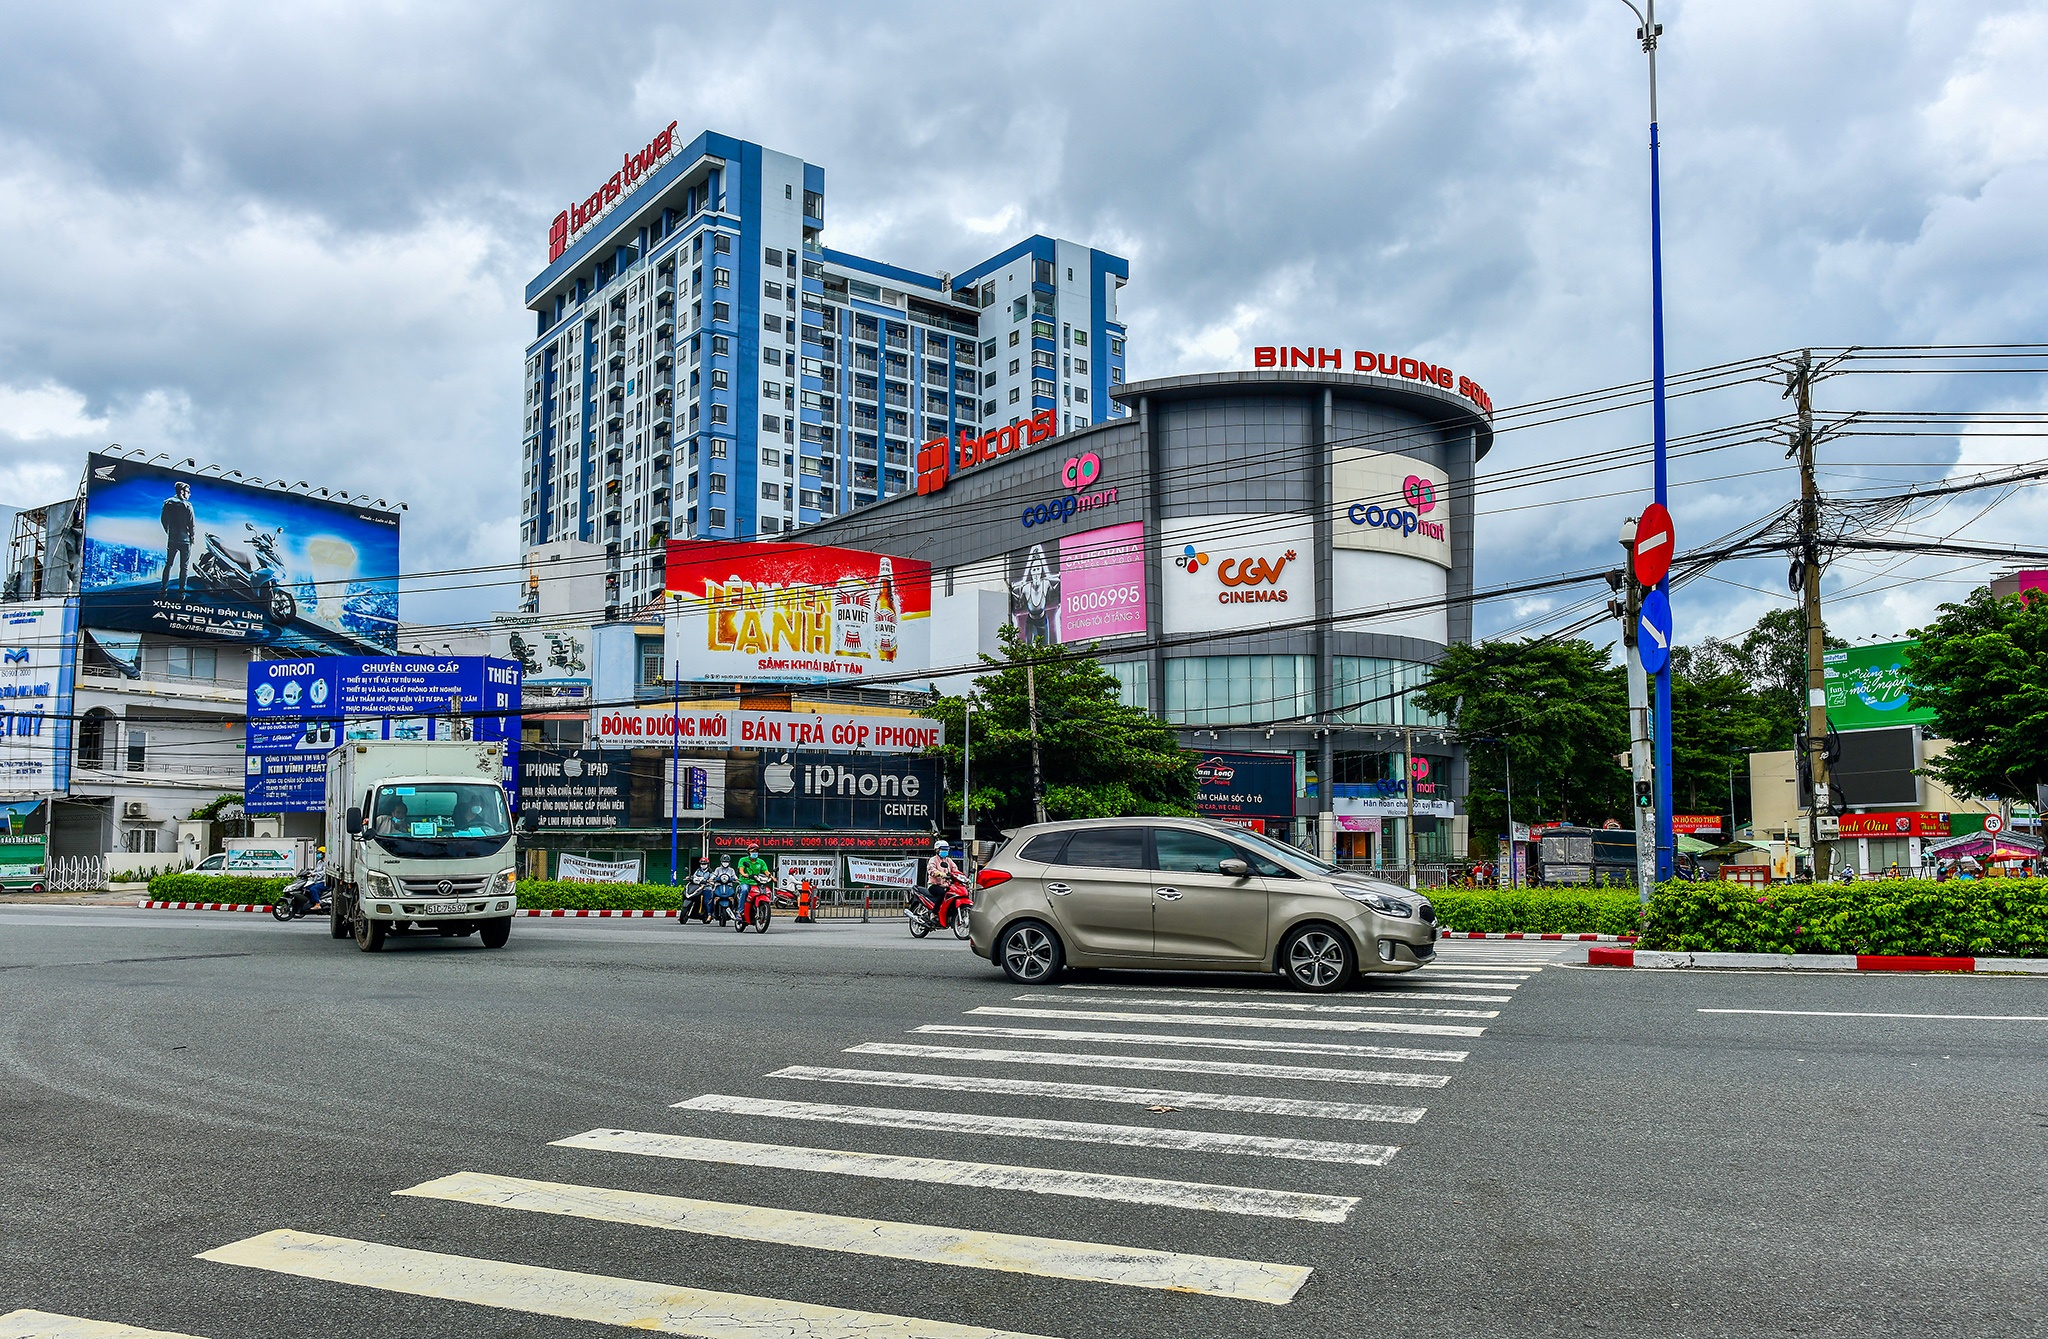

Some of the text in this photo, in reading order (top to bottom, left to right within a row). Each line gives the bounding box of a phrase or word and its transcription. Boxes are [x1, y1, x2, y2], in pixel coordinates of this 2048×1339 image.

[571, 120, 677, 235] biconsi tower
[1255, 346, 1342, 369] BINH
[1354, 350, 1453, 389] DUONG
[960, 408, 1057, 469] biconsi
[1175, 557, 1188, 568] CJ
[1217, 556, 1286, 587] CGV
[1067, 586, 1140, 613] 18006995
[1218, 590, 1288, 605] CINEMAS
[185, 604, 214, 615] DANH
[242, 610, 263, 620] LĨNH
[838, 609, 868, 624] BIA VIỆT
[152, 611, 264, 631] AIRBLADE
[1067, 617, 1091, 630] CHÚNG
[1135, 611, 1140, 619] 3
[707, 609, 833, 655] LẠNH
[269, 663, 315, 678] OMRON
[362, 660, 459, 672] CHUYÊN CUNG CẤP
[758, 656, 862, 675] SẢNG KHOÁI BẤT TẬN
[380, 676, 391, 684] VẬT
[487, 665, 519, 711] THIẾT BỊ
[601, 712, 727, 737] ĐÔNG DƯƠNG MỚI
[741, 714, 939, 748] BÁN TRẢ GÓP iPHONE
[268, 761, 327, 774] KIM VĨNH PHÁT
[526, 763, 608, 776] IPHONE IPAD
[804, 765, 920, 797] iPhone
[534, 785, 546, 796] BÁN
[572, 784, 584, 796] CÁC
[1209, 794, 1262, 803] CHĂM SÓC Ô TÔ
[1378, 800, 1394, 808] hoan
[884, 803, 928, 816] CENTER
[1680, 816, 1720, 824] HỘ CHO THUÊ
[714, 836, 732, 848] Quý
[734, 837, 760, 846] Khách
[763, 838, 780, 846] Liên
[857, 838, 876, 847] hoặc
[813, 867, 828, 875] 30W
